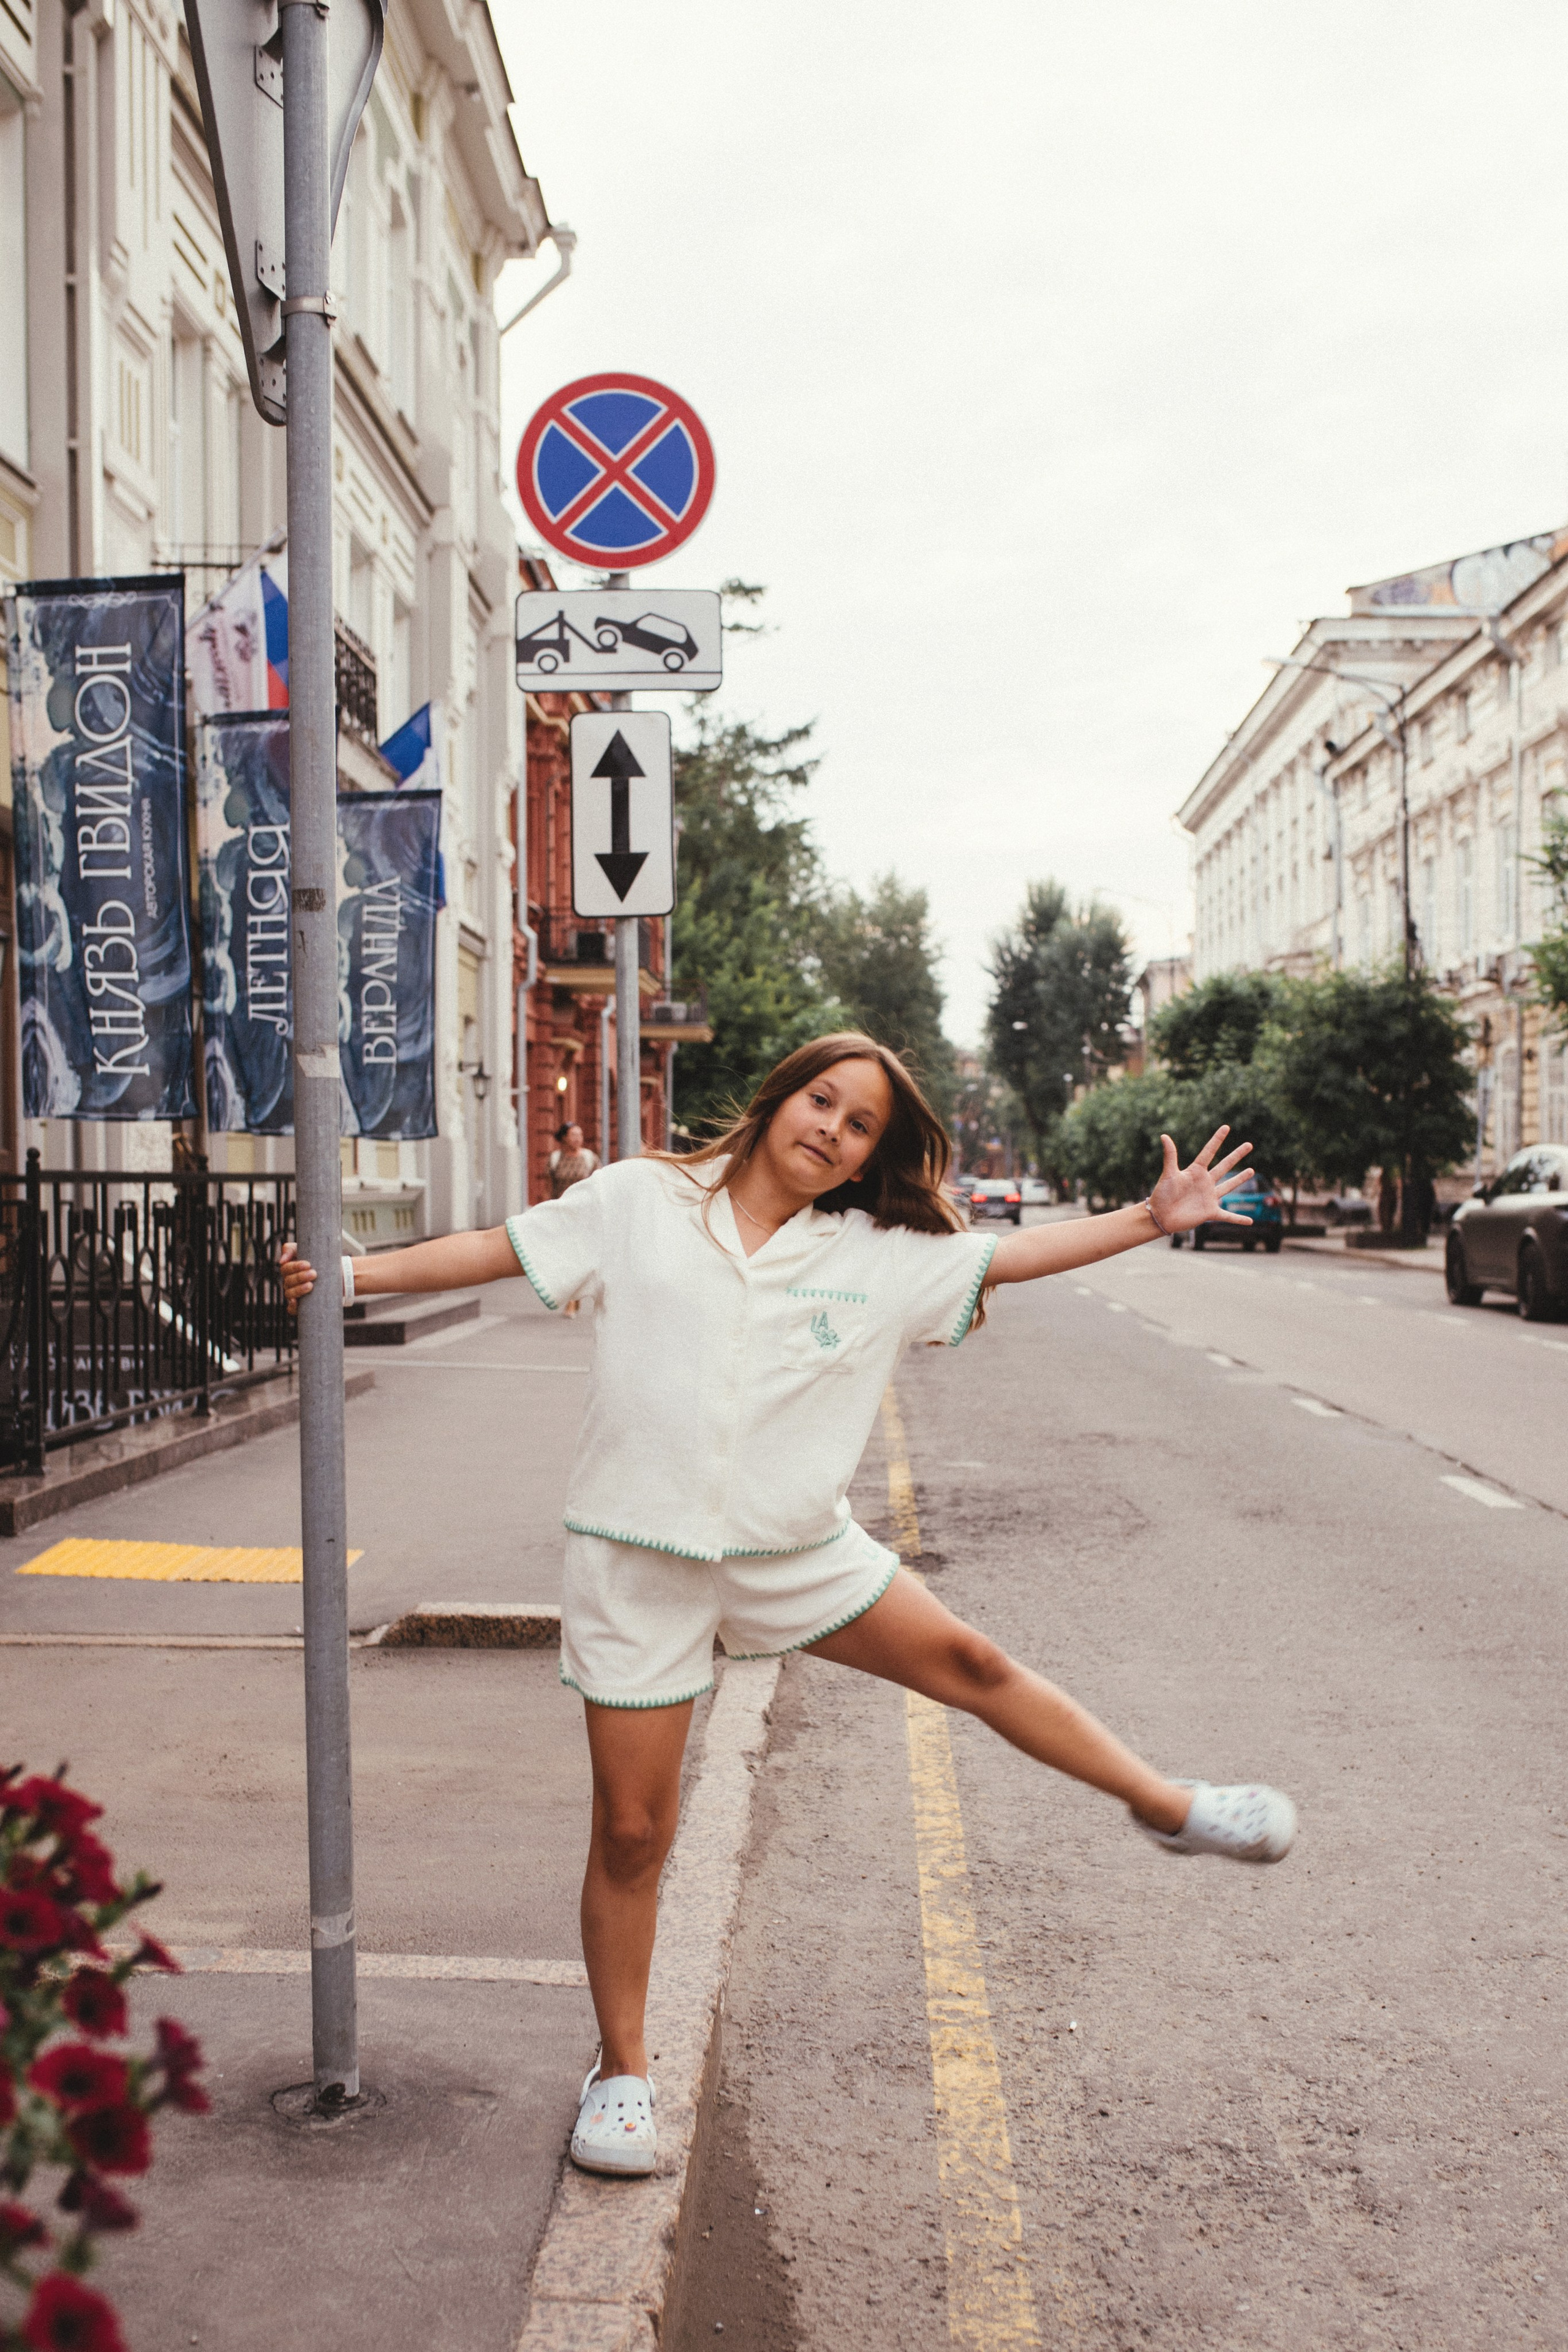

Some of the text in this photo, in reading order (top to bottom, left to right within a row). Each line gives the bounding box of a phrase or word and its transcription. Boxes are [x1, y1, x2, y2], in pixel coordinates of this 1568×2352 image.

[75, 642, 150, 1076] КНЯЗЬ ГВИДОН
[247, 823, 290, 1036] ЛЕТНЯЯ
[361, 876, 407, 1066] ВЕРАНДА
